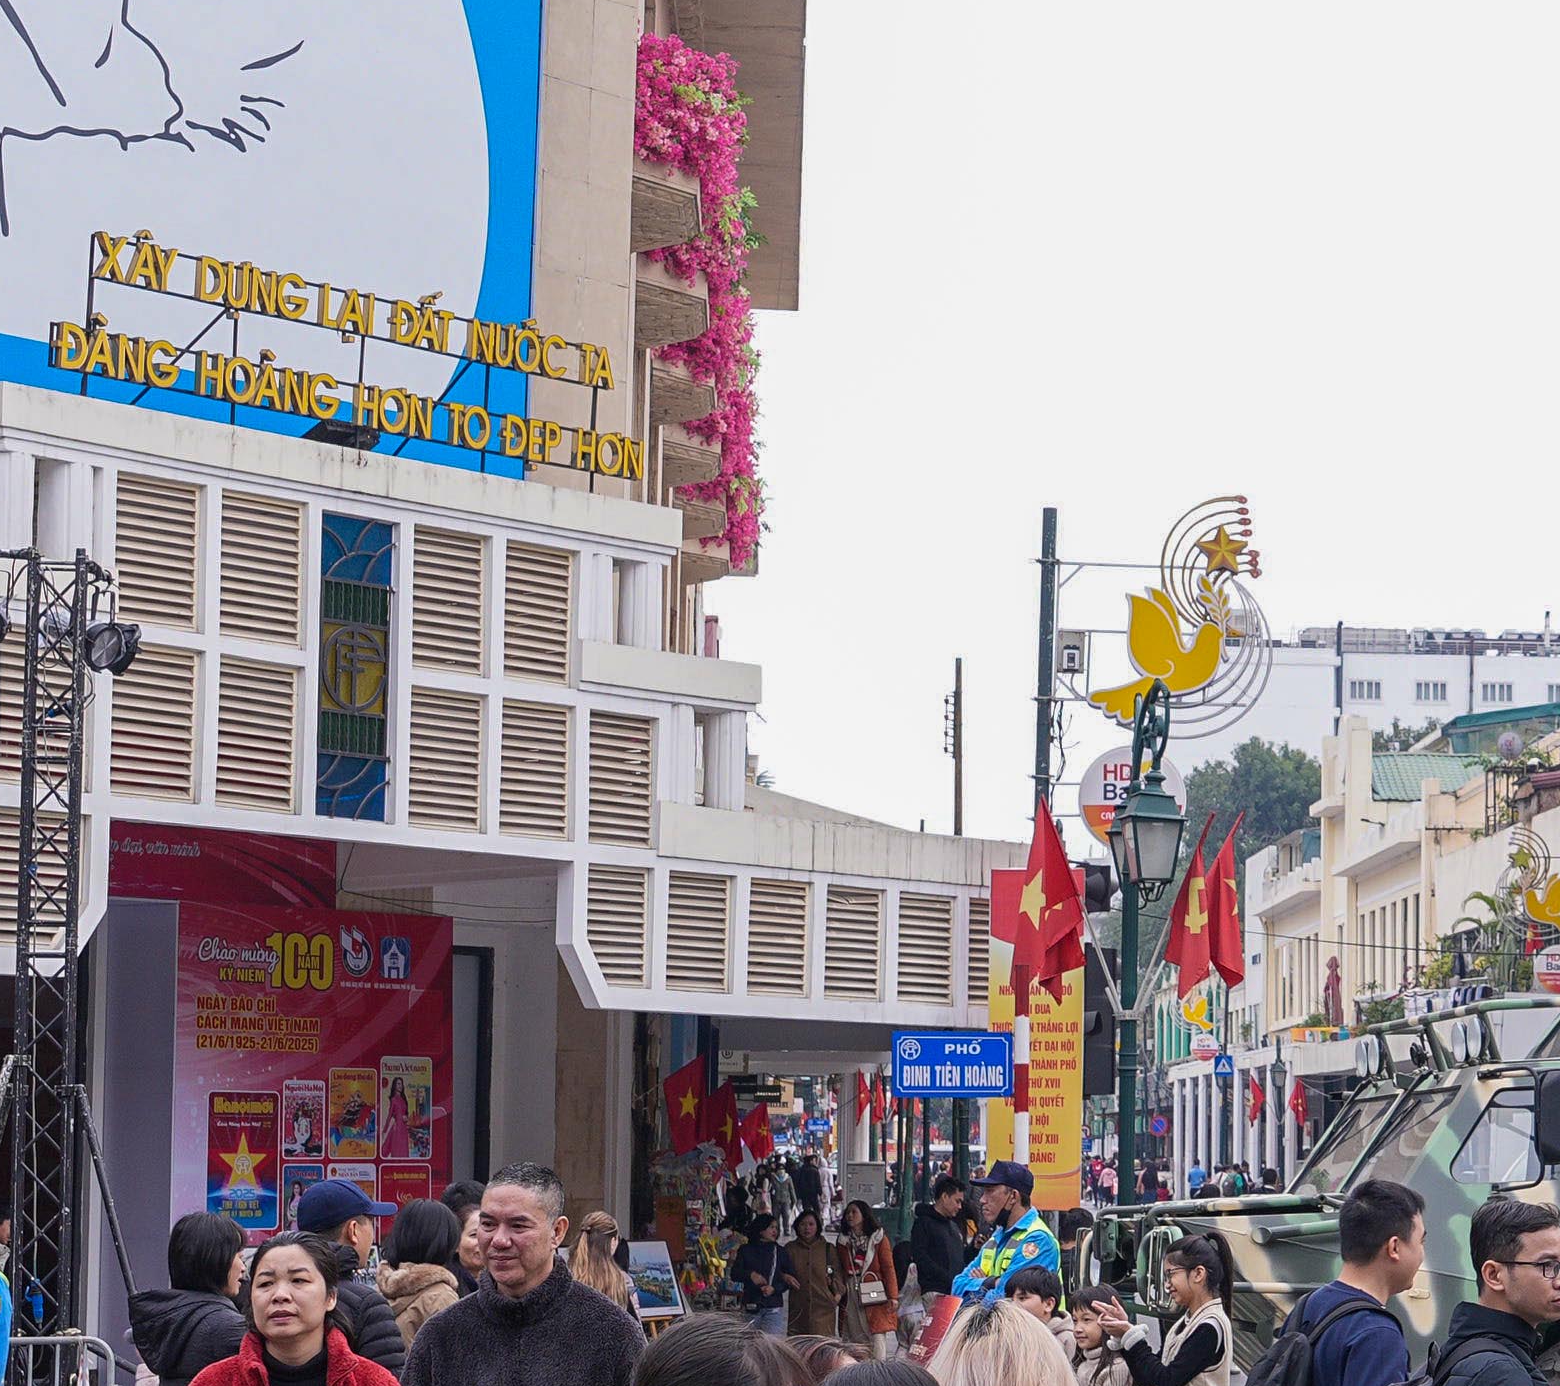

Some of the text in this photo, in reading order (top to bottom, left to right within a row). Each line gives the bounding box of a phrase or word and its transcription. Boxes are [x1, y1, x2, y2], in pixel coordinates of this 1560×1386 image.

[93, 229, 615, 390] XÂY DỰNG LẠI ĐẤT NƯỚC TA
[51, 312, 645, 481] ĐÀNG HOÀNG HƠN TO ĐẸP HƠN
[1103, 763, 1132, 782] HD
[198, 936, 280, 974] Chào mừng
[236, 966, 265, 984] NIỆM
[265, 932, 335, 991] 100
[196, 994, 277, 1012] NGÀY BÁO CHÍ
[196, 1013, 320, 1035] CÁCH MẠNG VIỆT NAM
[196, 1034, 320, 1053] (21/6/1925-21/6/2025)
[944, 1038, 983, 1054] PHỐ
[902, 1060, 1004, 1087] ĐINH TIÊN HOÀNG
